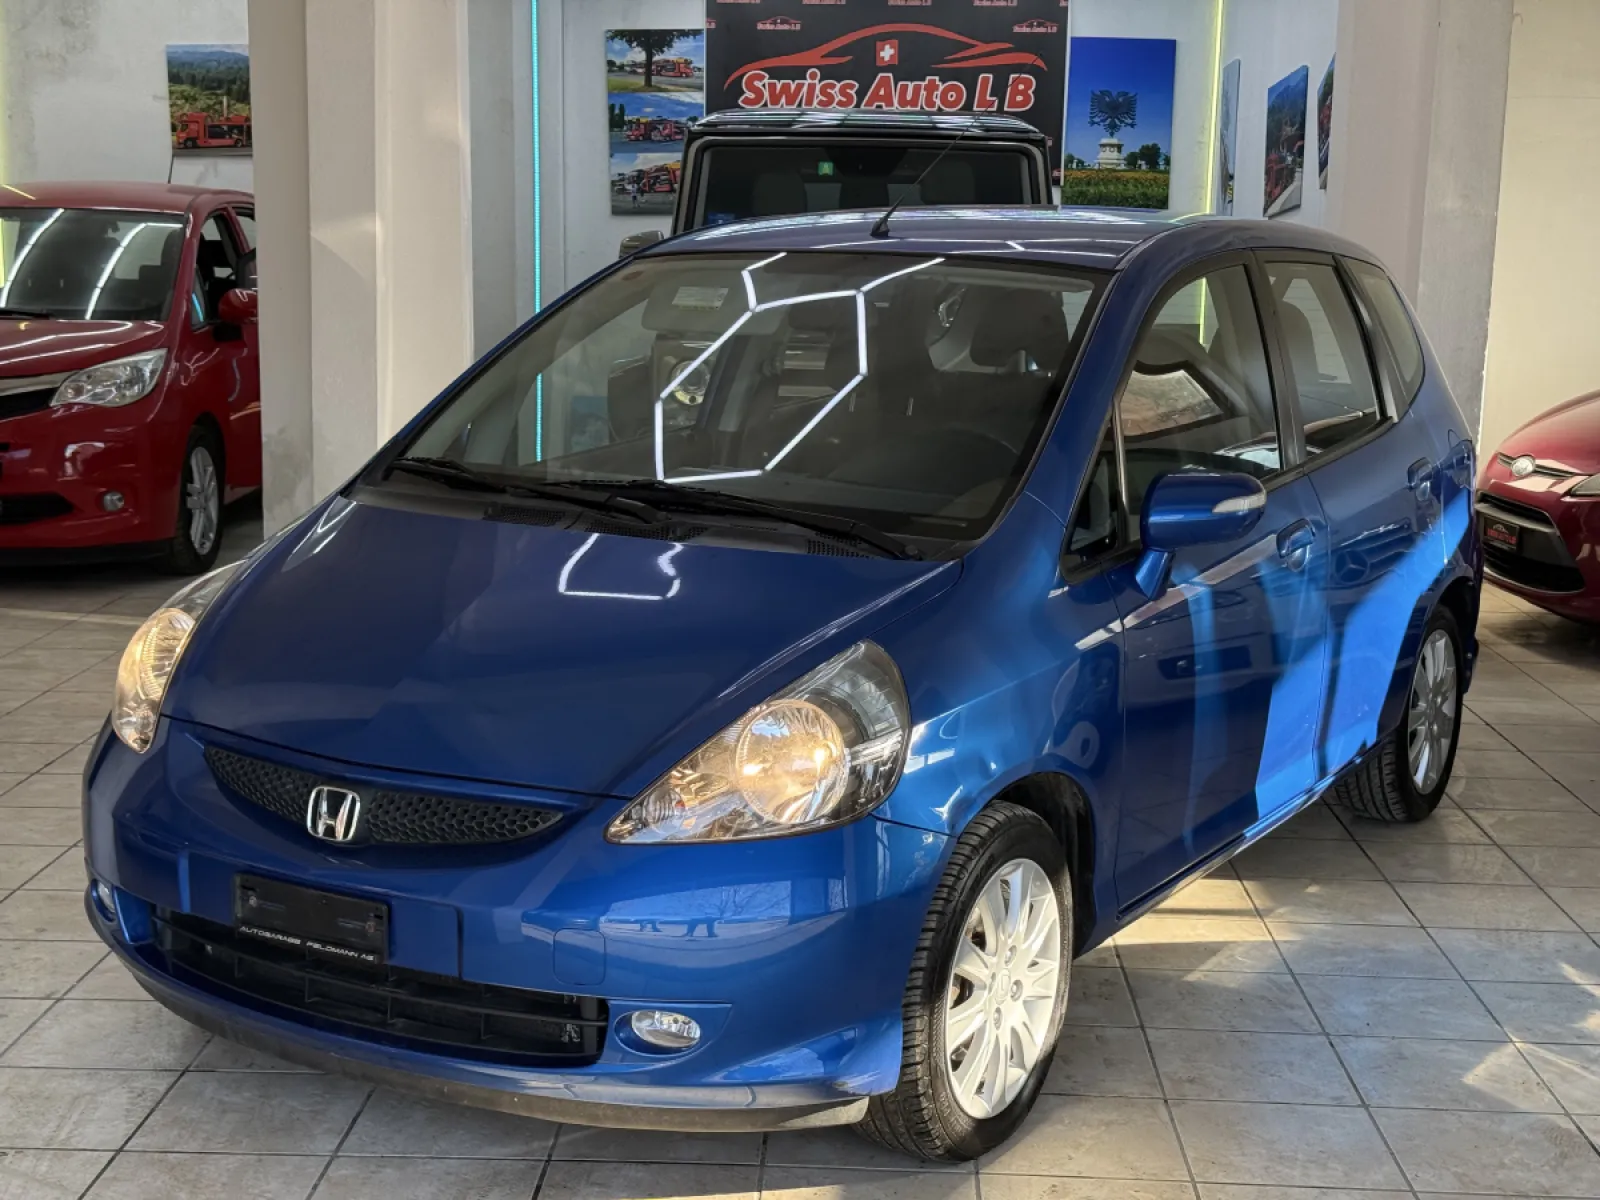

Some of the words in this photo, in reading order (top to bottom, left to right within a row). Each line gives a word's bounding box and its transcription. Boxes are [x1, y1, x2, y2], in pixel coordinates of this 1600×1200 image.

[738, 68, 859, 109] Swiss
[861, 73, 967, 111] Auto
[973, 73, 998, 111] L
[1004, 73, 1036, 111] B
